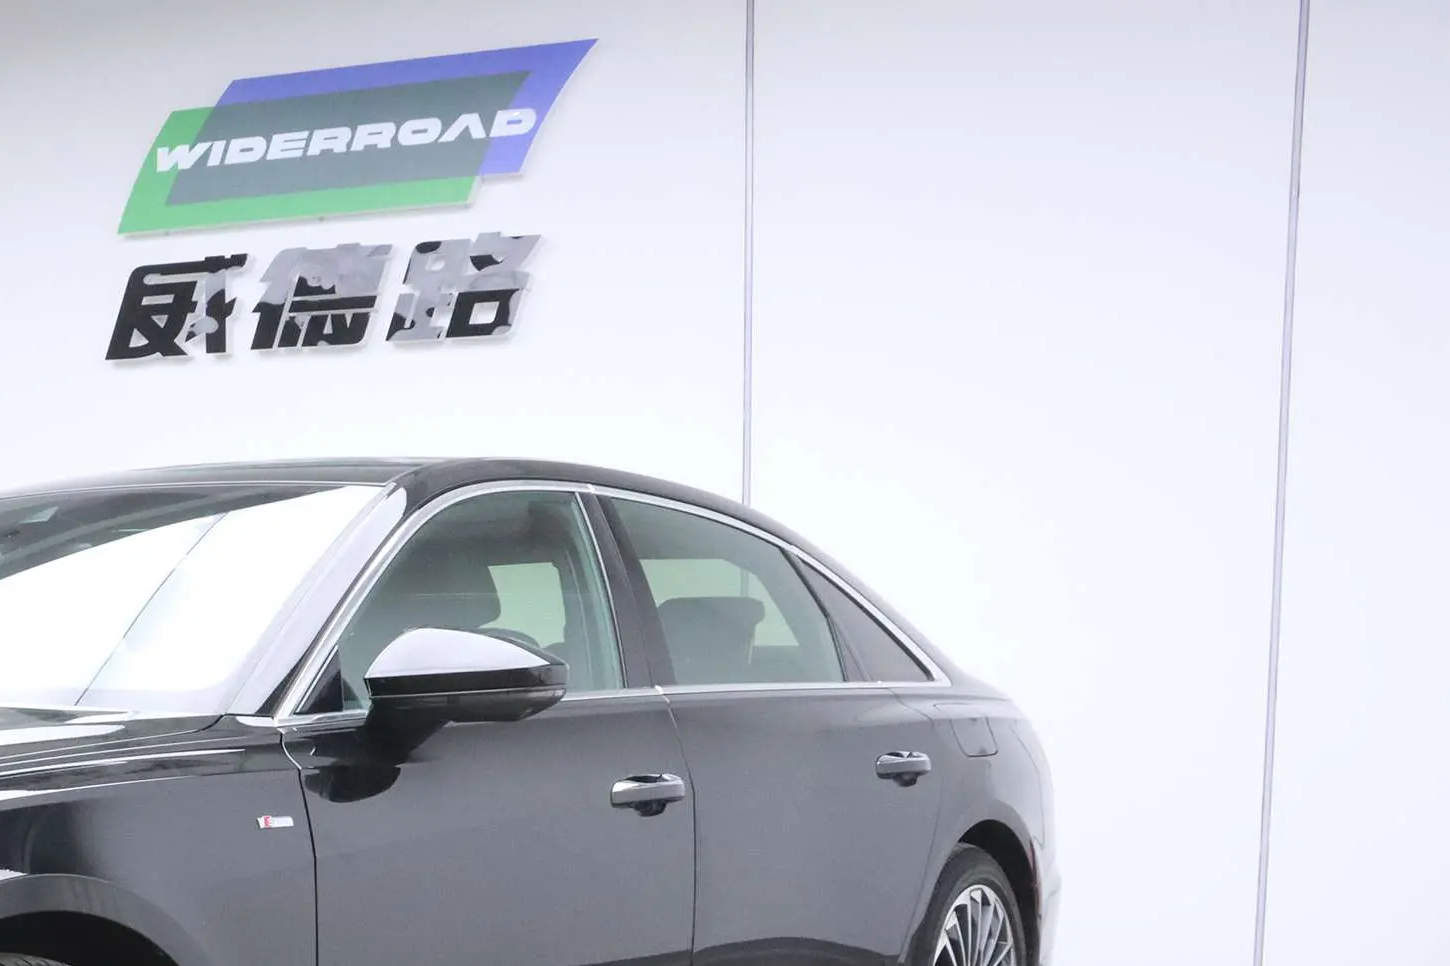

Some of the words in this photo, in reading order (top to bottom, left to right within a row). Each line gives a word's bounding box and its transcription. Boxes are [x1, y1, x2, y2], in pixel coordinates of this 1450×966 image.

[156, 108, 537, 173] WIDERROAD
[104, 231, 543, 361] 威德路
